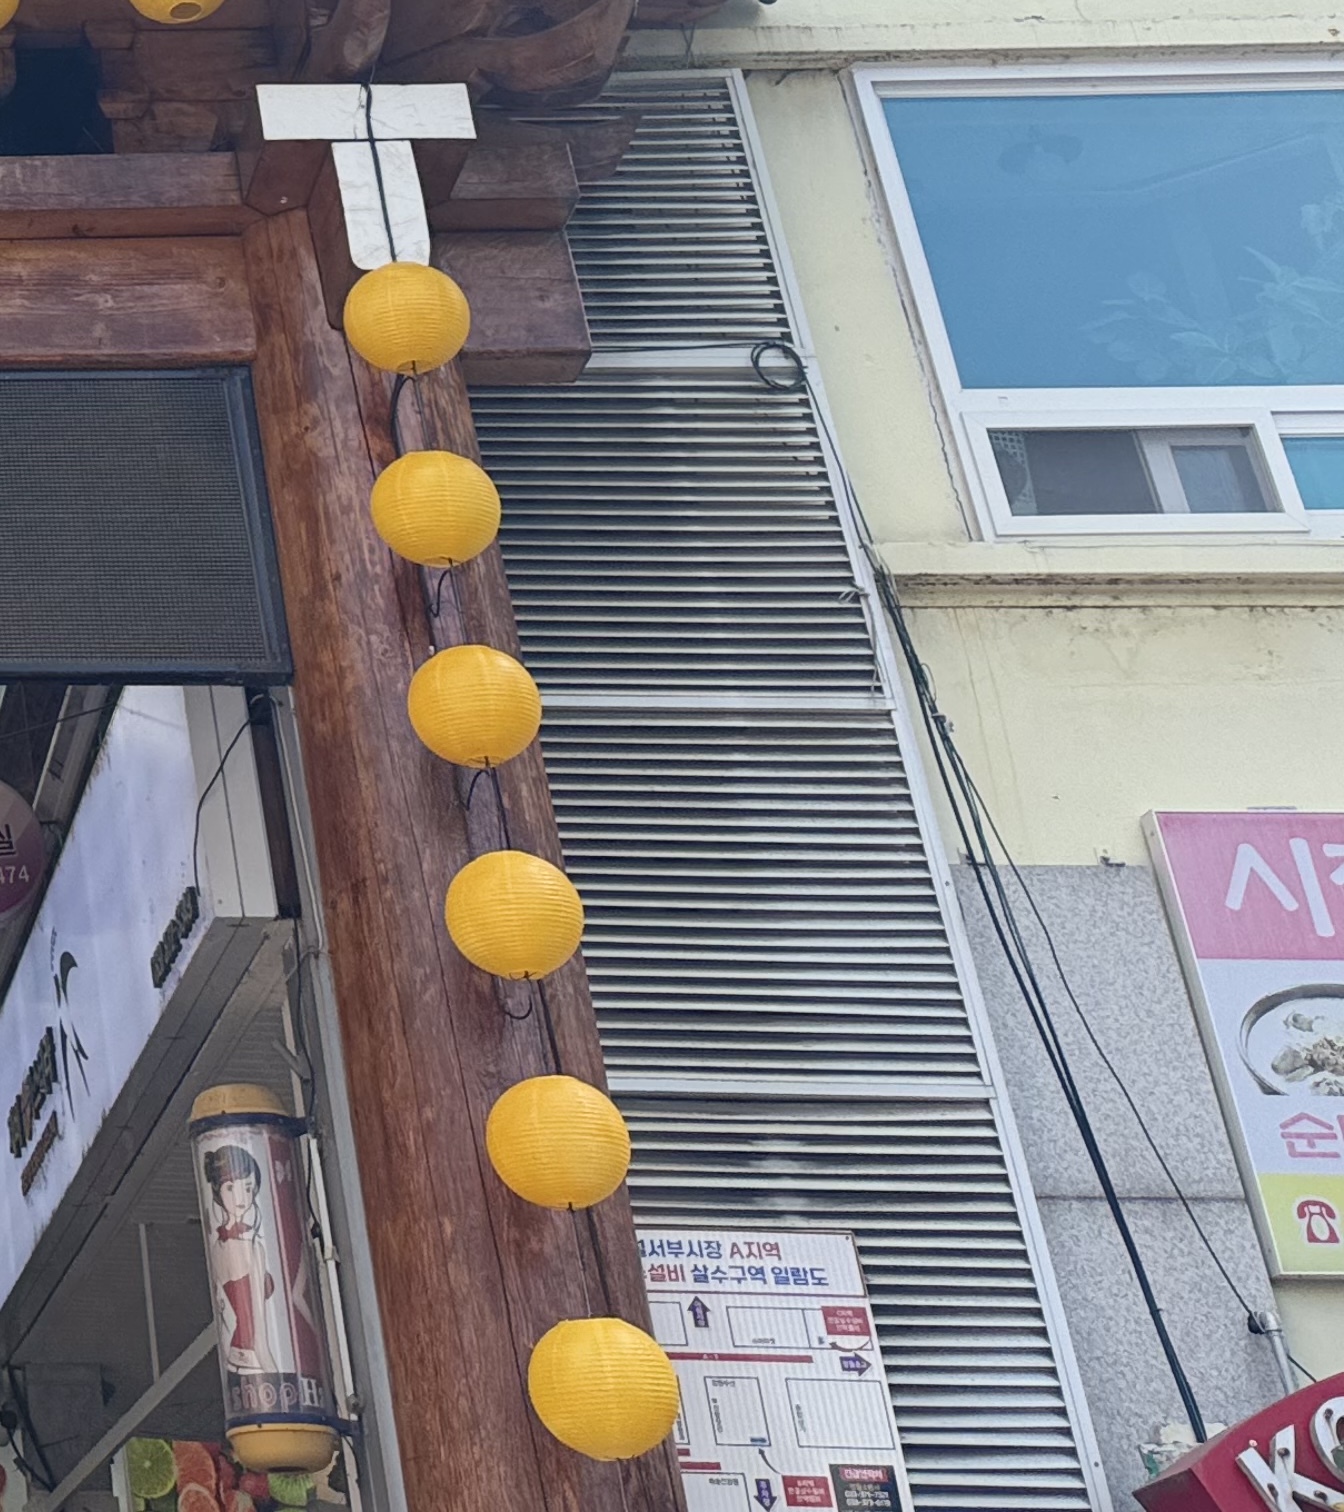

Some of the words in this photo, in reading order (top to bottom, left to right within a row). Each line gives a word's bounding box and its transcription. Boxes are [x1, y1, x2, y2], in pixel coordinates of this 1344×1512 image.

[1277, 1110, 1344, 1160] 순
[730, 1241, 782, 1260] A지역
[643, 1263, 686, 1283] 설비
[690, 1264, 768, 1285] 살수구역
[771, 1267, 830, 1287] 일람도
